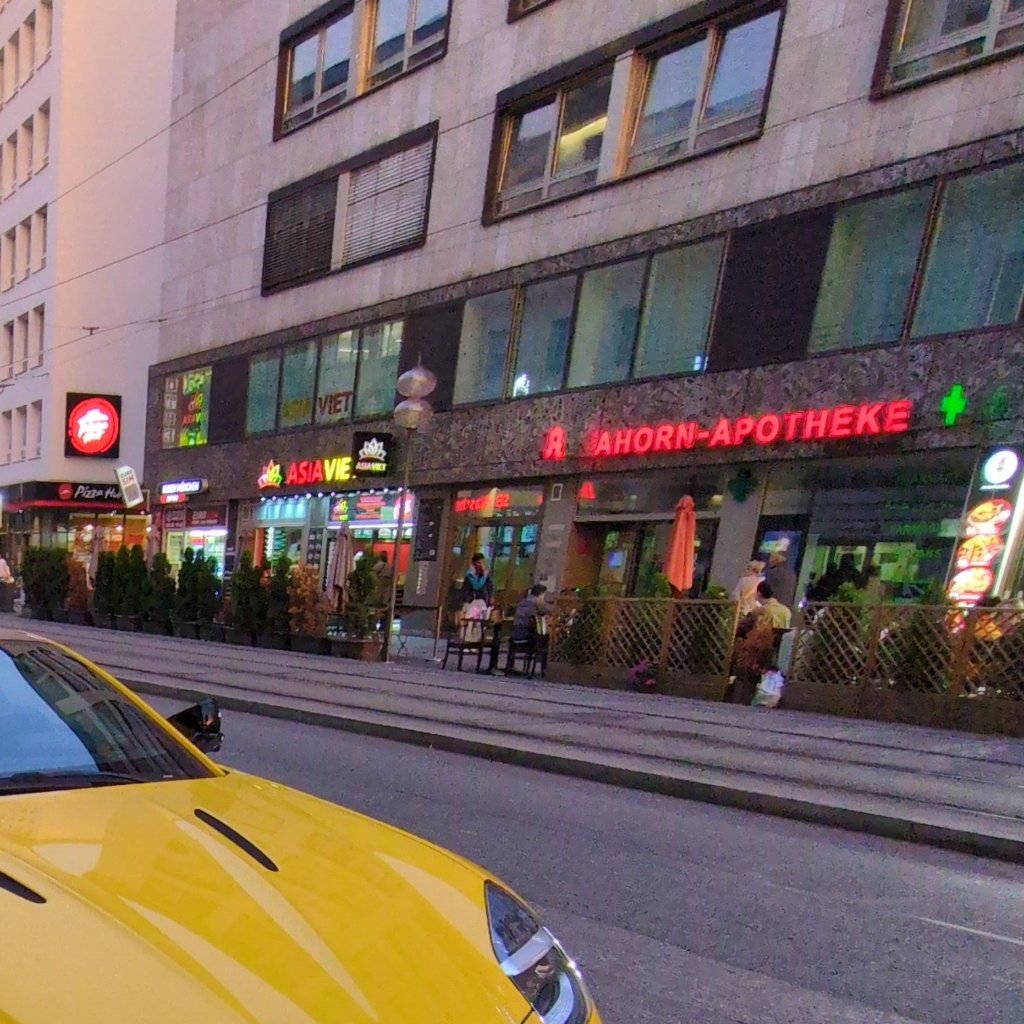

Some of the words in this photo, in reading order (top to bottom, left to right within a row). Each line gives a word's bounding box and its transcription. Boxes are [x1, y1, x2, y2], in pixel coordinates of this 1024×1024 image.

[318, 391, 352, 416] VIET
[593, 400, 913, 456] AHORN-APOTHEKE
[286, 457, 357, 485] ASIAVIE
[74, 485, 103, 499] Pizza
